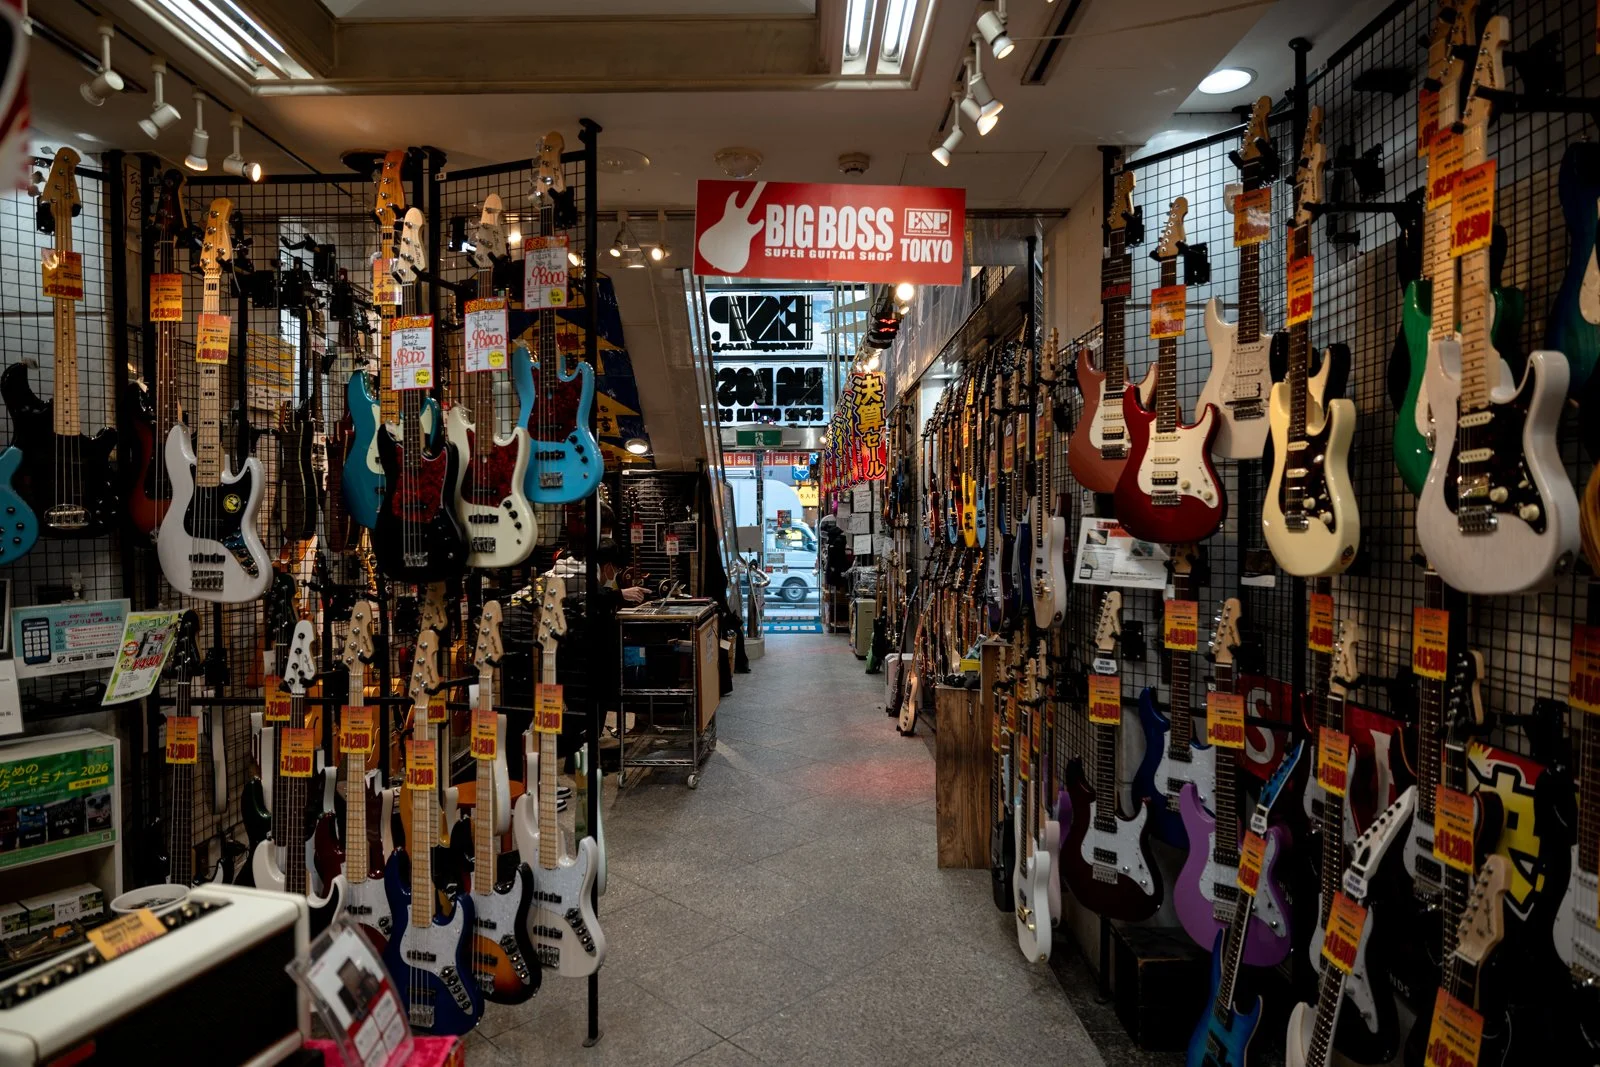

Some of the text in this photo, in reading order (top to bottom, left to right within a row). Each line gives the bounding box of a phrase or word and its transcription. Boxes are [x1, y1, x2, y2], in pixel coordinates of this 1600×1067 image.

[765, 204, 893, 252] BIG BOSS
[908, 211, 948, 230] ESP
[765, 248, 893, 261] SUPER GUITAR SHOP
[900, 238, 952, 263] TOKYO
[852, 373, 886, 479] 決算セール
[80, 762, 109, 776] 2026
[58, 905, 77, 918] FLY
